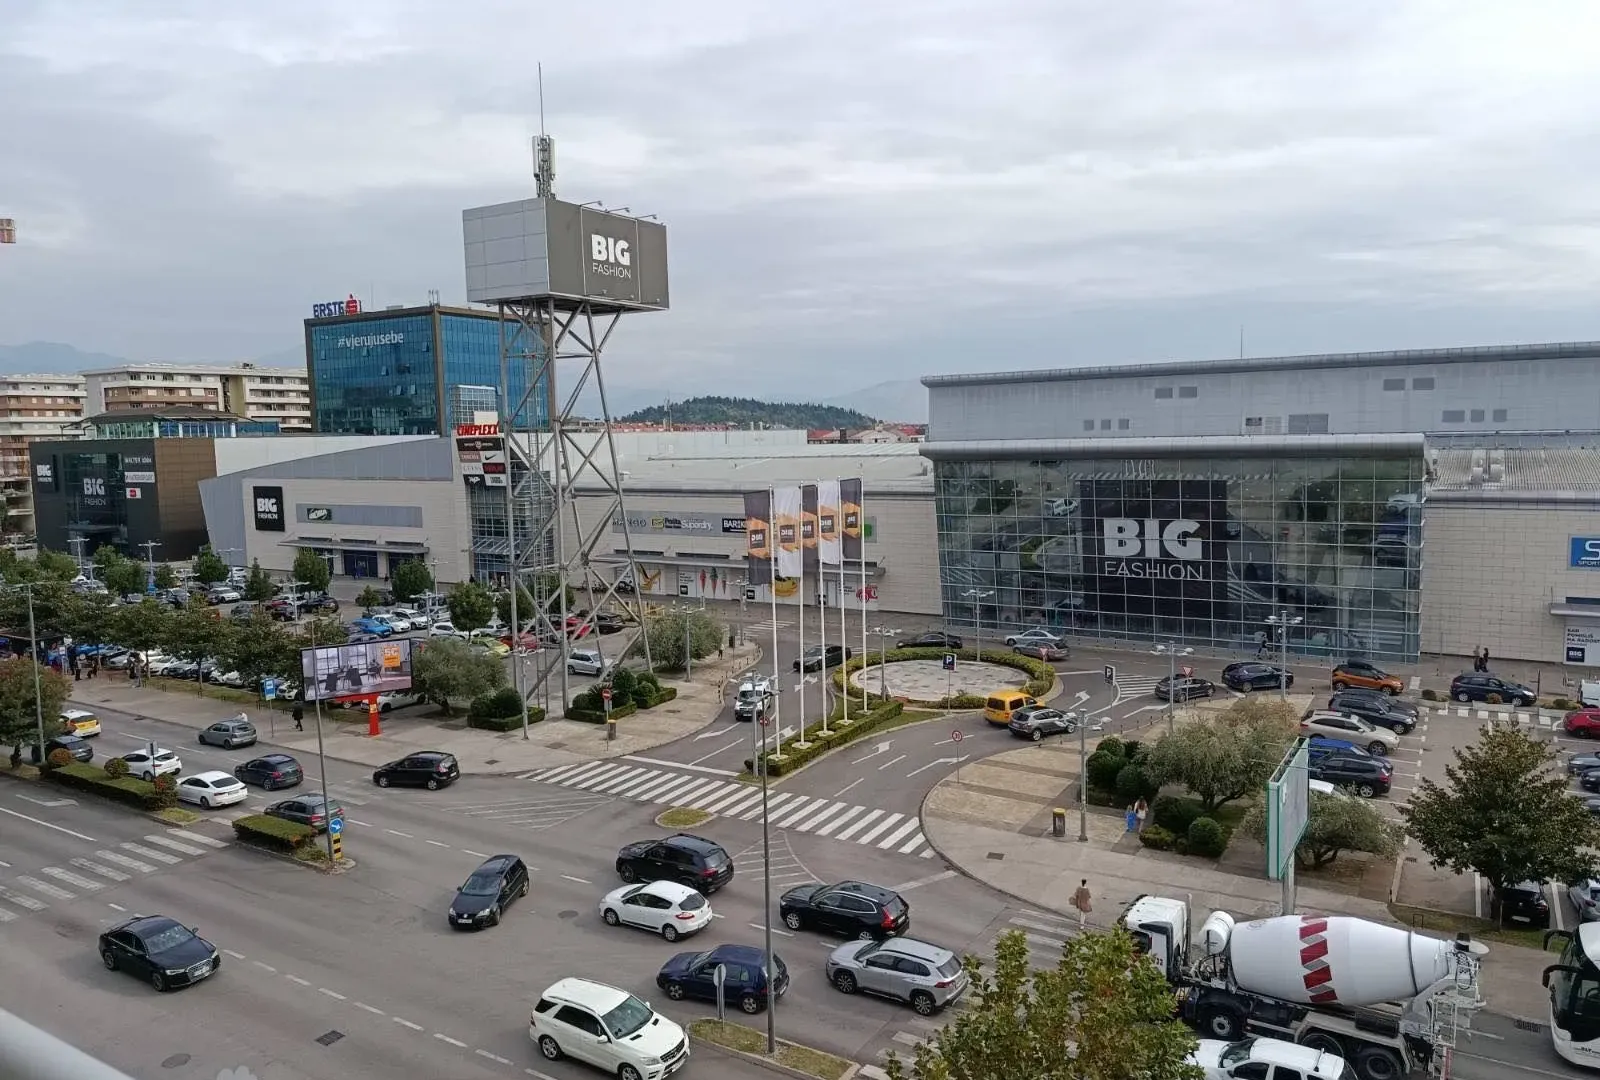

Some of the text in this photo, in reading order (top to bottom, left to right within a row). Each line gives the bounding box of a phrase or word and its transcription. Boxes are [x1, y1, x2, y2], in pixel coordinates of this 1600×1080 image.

[592, 234, 631, 266] BIG
[592, 262, 632, 279] FASHION
[338, 331, 404, 349] #vjerujusebe
[457, 422, 499, 436] CINEPLEXX
[37, 465, 51, 476] BIG
[84, 478, 104, 495] BIG
[257, 498, 277, 512] BIG
[257, 512, 279, 520] FASHION
[1104, 519, 1202, 559] BIG
[1105, 561, 1203, 580] FASHION
[946, 655, 953, 664] P
